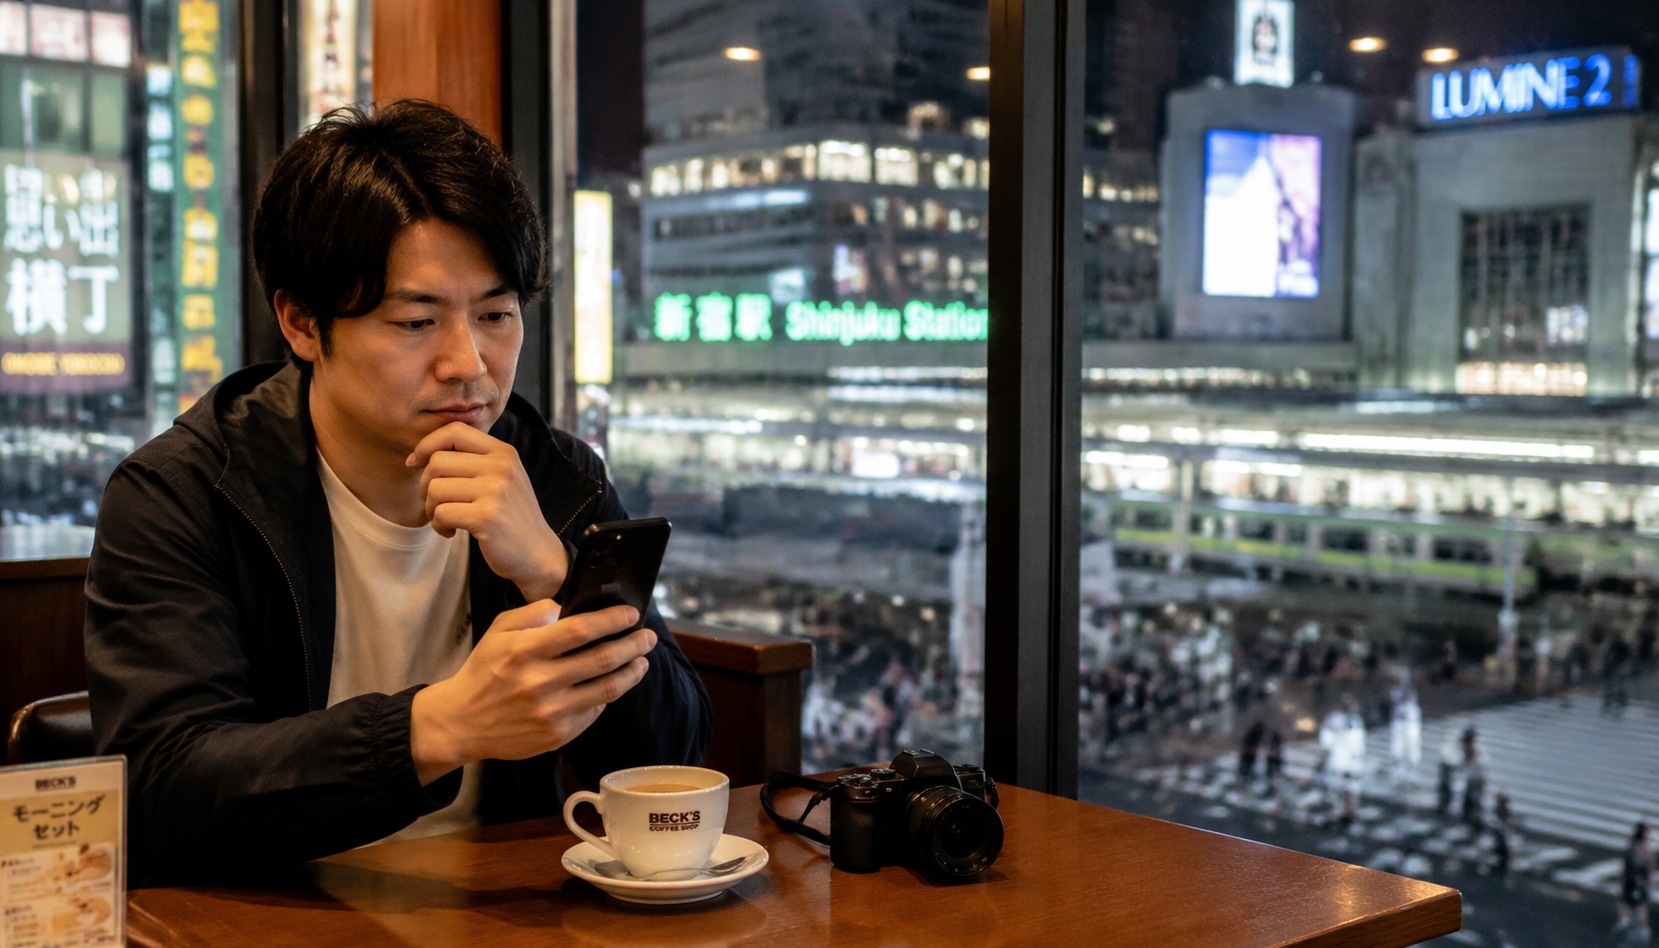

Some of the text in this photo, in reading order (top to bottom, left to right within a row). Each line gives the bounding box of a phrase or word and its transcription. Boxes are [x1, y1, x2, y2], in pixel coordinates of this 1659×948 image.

[1431, 56, 1581, 120] LUMINE
[1583, 54, 1612, 107] 2
[654, 292, 772, 341] 新宿駅
[786, 301, 900, 346] Shinjuku
[35, 776, 76, 789] BECK'S
[13, 794, 106, 822] モーニング
[649, 811, 700, 823] BECK'S
[34, 820, 80, 840] セット
